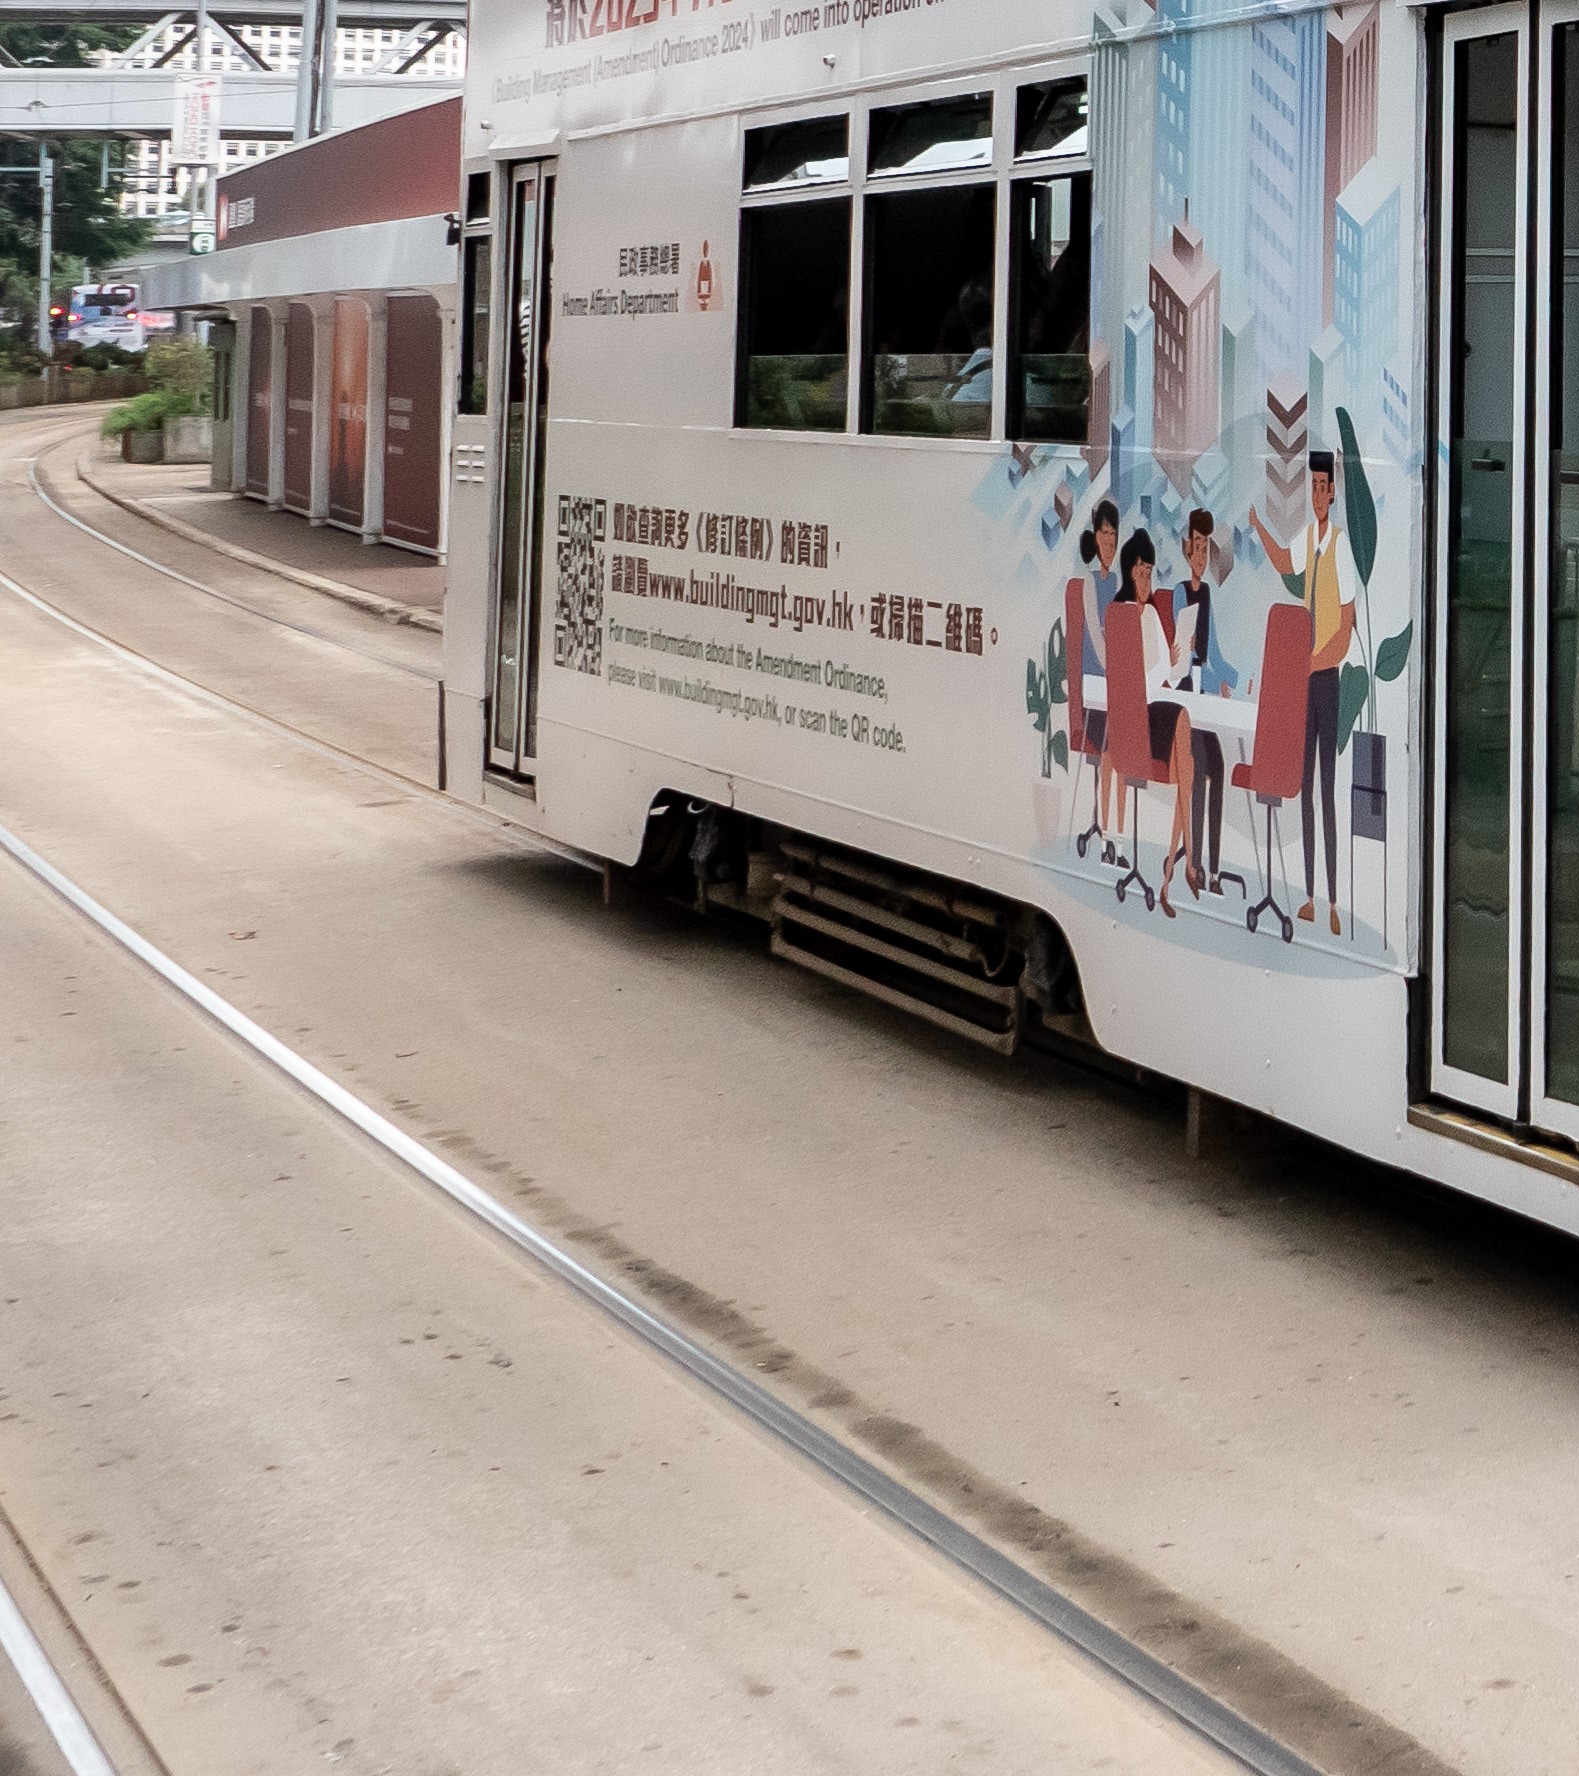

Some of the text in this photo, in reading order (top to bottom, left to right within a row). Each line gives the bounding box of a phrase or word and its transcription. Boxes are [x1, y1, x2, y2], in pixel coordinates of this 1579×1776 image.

[661, 33, 718, 67] Ordinance
[760, 8, 780, 42] will
[784, 4, 819, 37] come
[705, 638, 734, 666] about
[735, 643, 753, 670] the
[756, 646, 822, 685] Amendment
[825, 659, 888, 705] Ordinance,
[784, 705, 797, 725] or
[799, 707, 827, 734] scan
[829, 708, 848, 739] the
[851, 712, 870, 744] QR
[873, 722, 906, 754] code.
